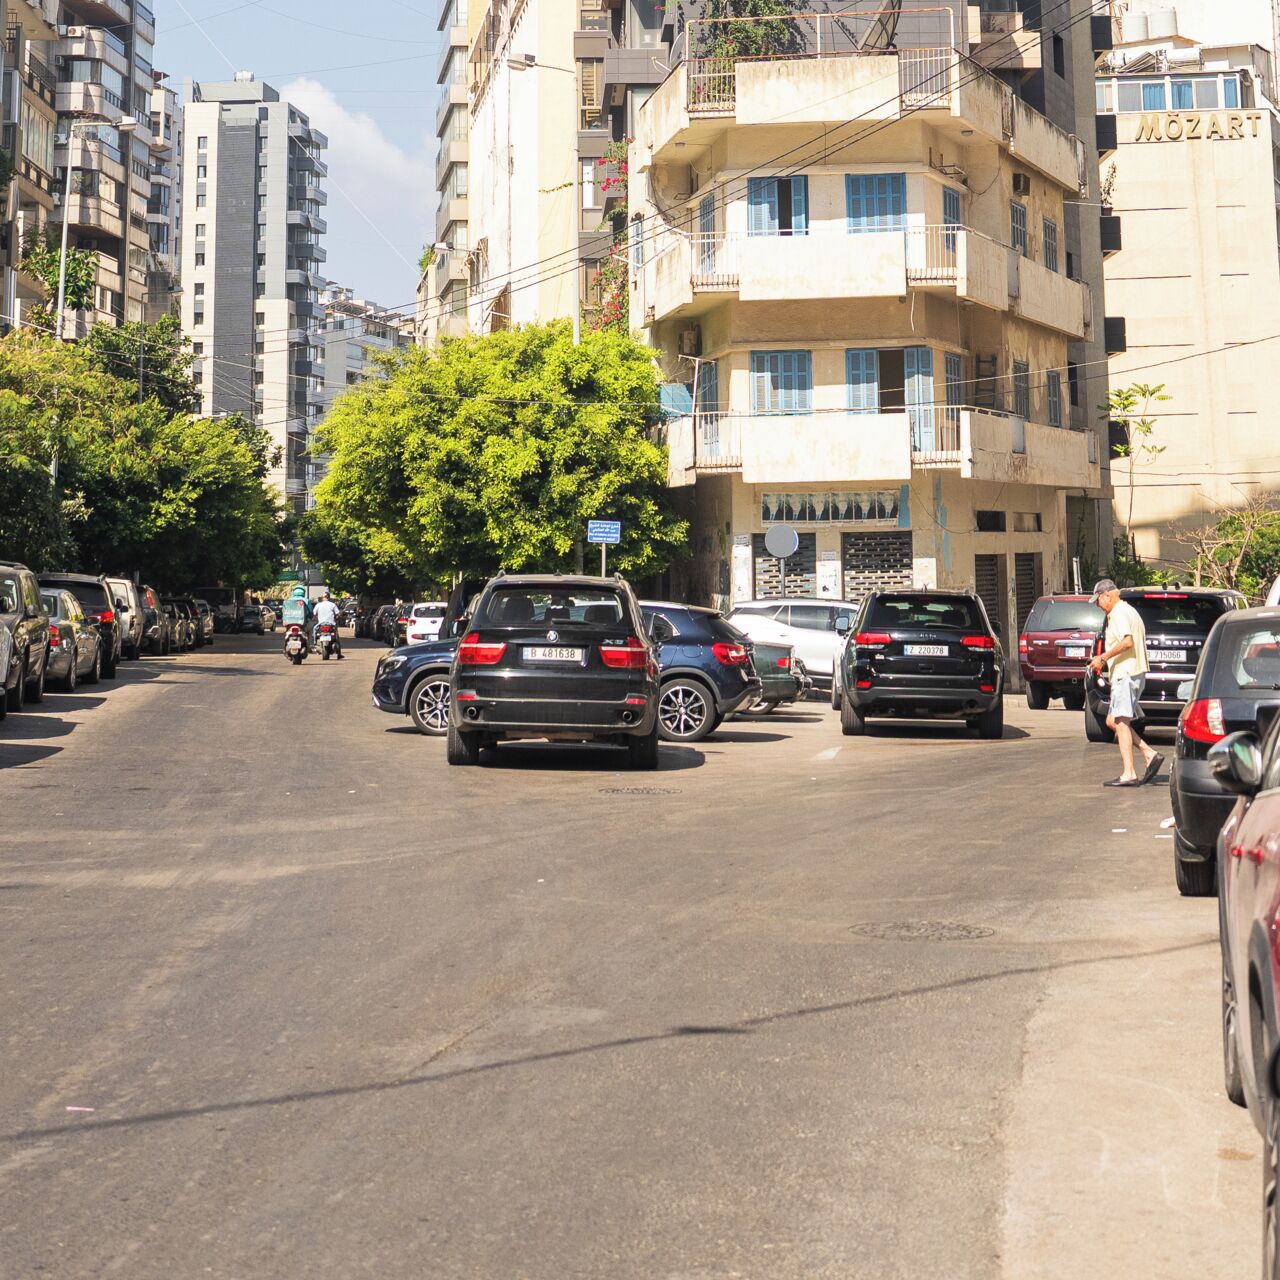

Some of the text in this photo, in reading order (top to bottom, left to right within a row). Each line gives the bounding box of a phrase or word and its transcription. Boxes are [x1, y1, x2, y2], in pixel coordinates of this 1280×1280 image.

[530, 648, 576, 658] B 481638
[918, 646, 944, 655] 220378
[1154, 651, 1181, 659] 715066
